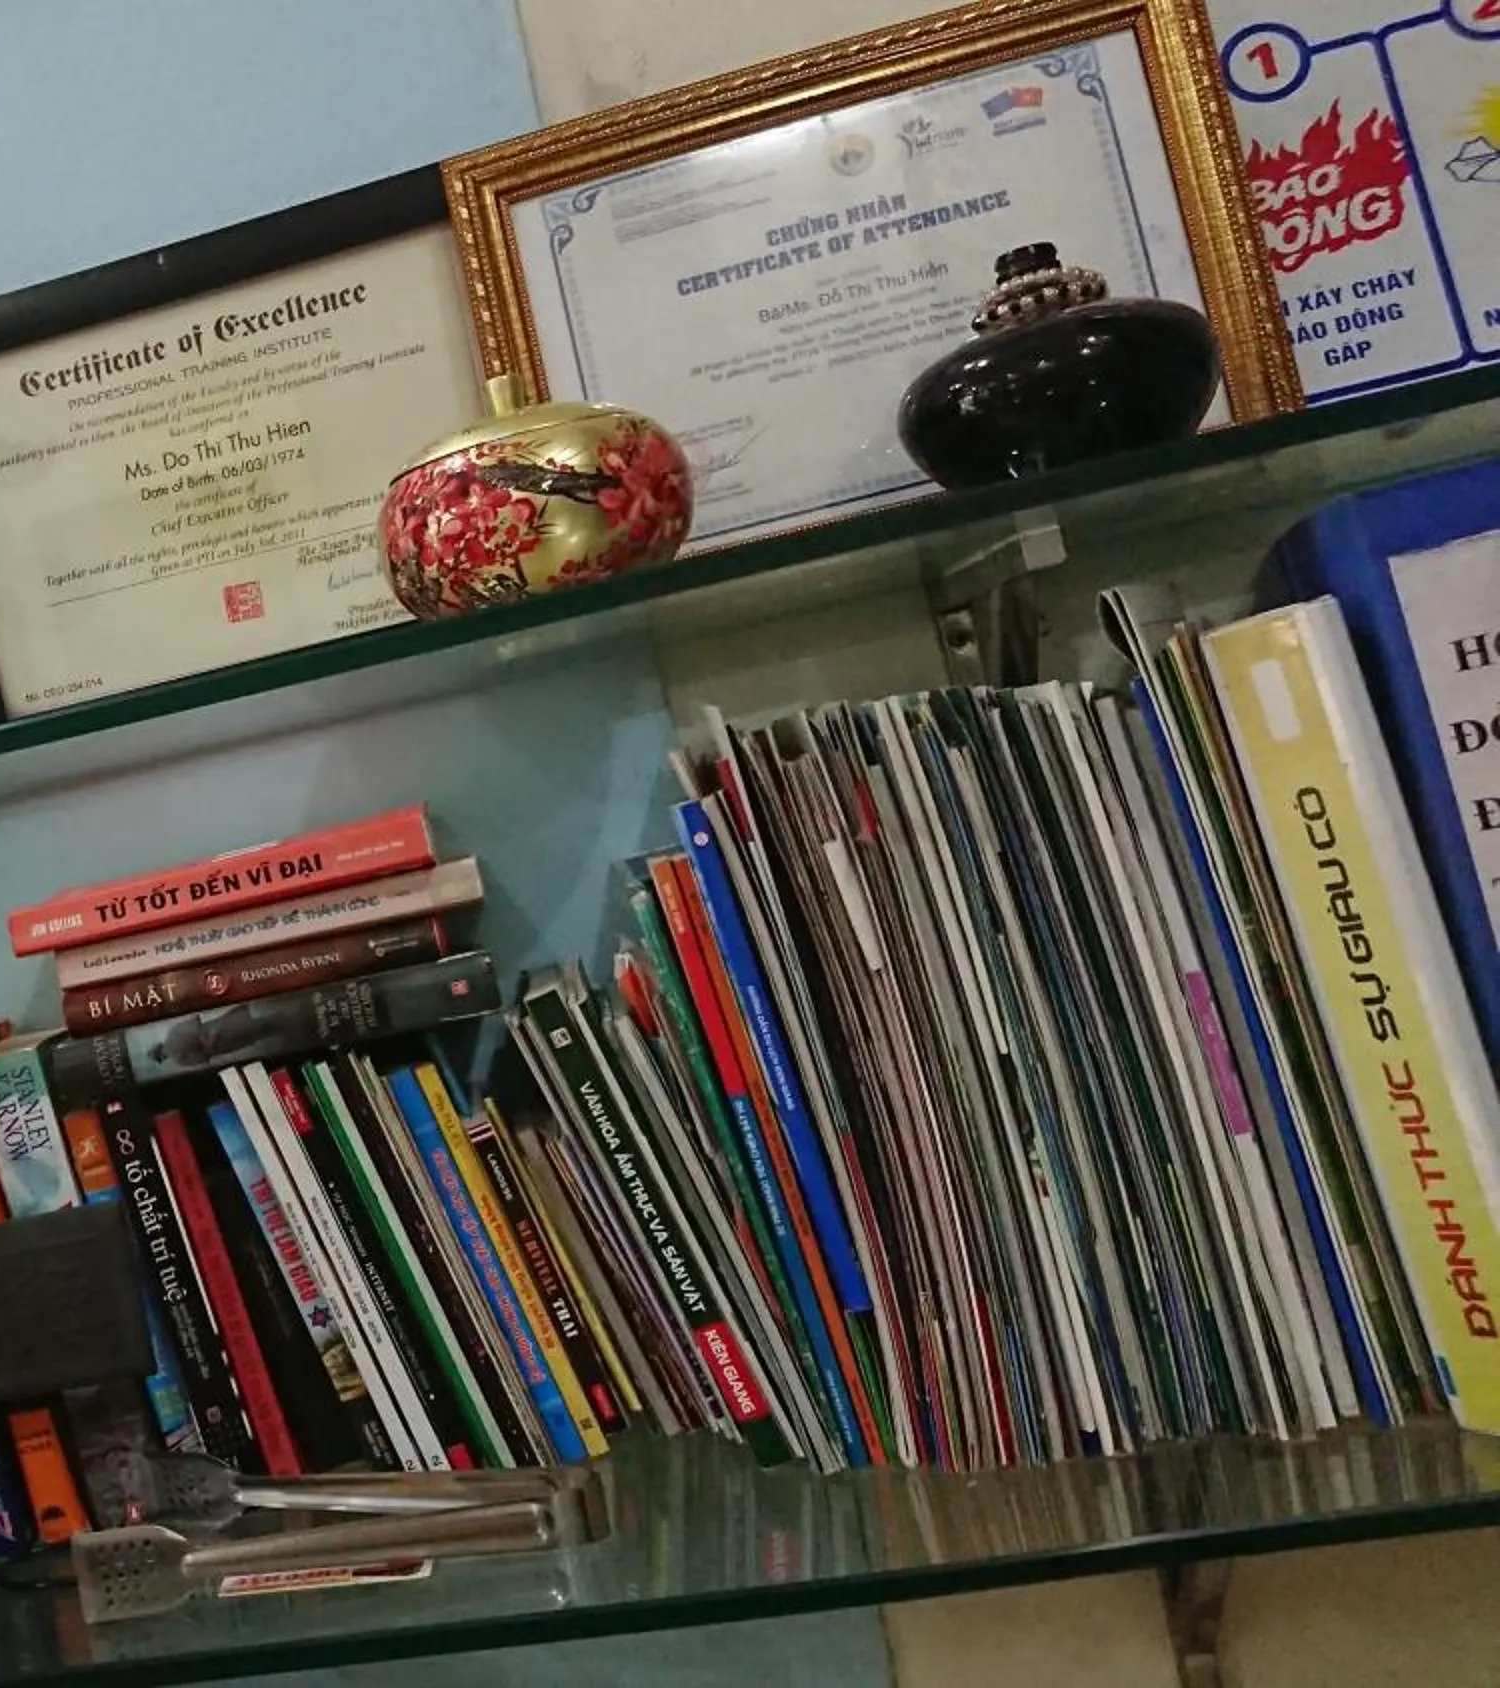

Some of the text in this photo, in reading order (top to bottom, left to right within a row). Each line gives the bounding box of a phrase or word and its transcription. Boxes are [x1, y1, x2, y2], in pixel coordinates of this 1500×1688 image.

[1246, 41, 1279, 80] 1
[676, 240, 823, 297] CERTIFICATE
[826, 229, 856, 255] OF
[862, 189, 1012, 246] ATTENDANCE
[19, 283, 368, 397] Certificate of Excellence
[1335, 302, 1404, 334] ĐỘNG
[68, 327, 334, 410] PROFESSIONAL TRAINING INSTITUTE
[125, 419, 312, 481] Ms. Do Thi Thu Hien
[140, 485, 169, 501] Date
[171, 477, 183, 493] of
[221, 448, 306, 480] 06/03/1974
[151, 516, 183, 538] Chief
[1294, 786, 1336, 851] CÓ
[94, 897, 127, 923] TỪ
[133, 884, 180, 913] TỐT
[189, 868, 241, 901] ĐẾN
[245, 861, 273, 886] VĨ
[279, 853, 324, 879] ĐẠI
[1317, 857, 1373, 965] GIÀU
[88, 993, 111, 1019] BÍ
[123, 983, 177, 1011] MẬT
[241, 962, 300, 983] RHONDA
[1350, 970, 1401, 1044] SỰ
[11, 1065, 52, 1151] STANLEY
[1382, 1060, 1446, 1192] THỨC
[125, 1159, 153, 1184] tố
[628, 1178, 658, 1220] THỰC
[133, 1187, 169, 1235] chất
[150, 1237, 176, 1263] trí
[159, 1266, 188, 1302] tuệ
[552, 1297, 579, 1339] THAI
[723, 1364, 757, 1415] GIANG
